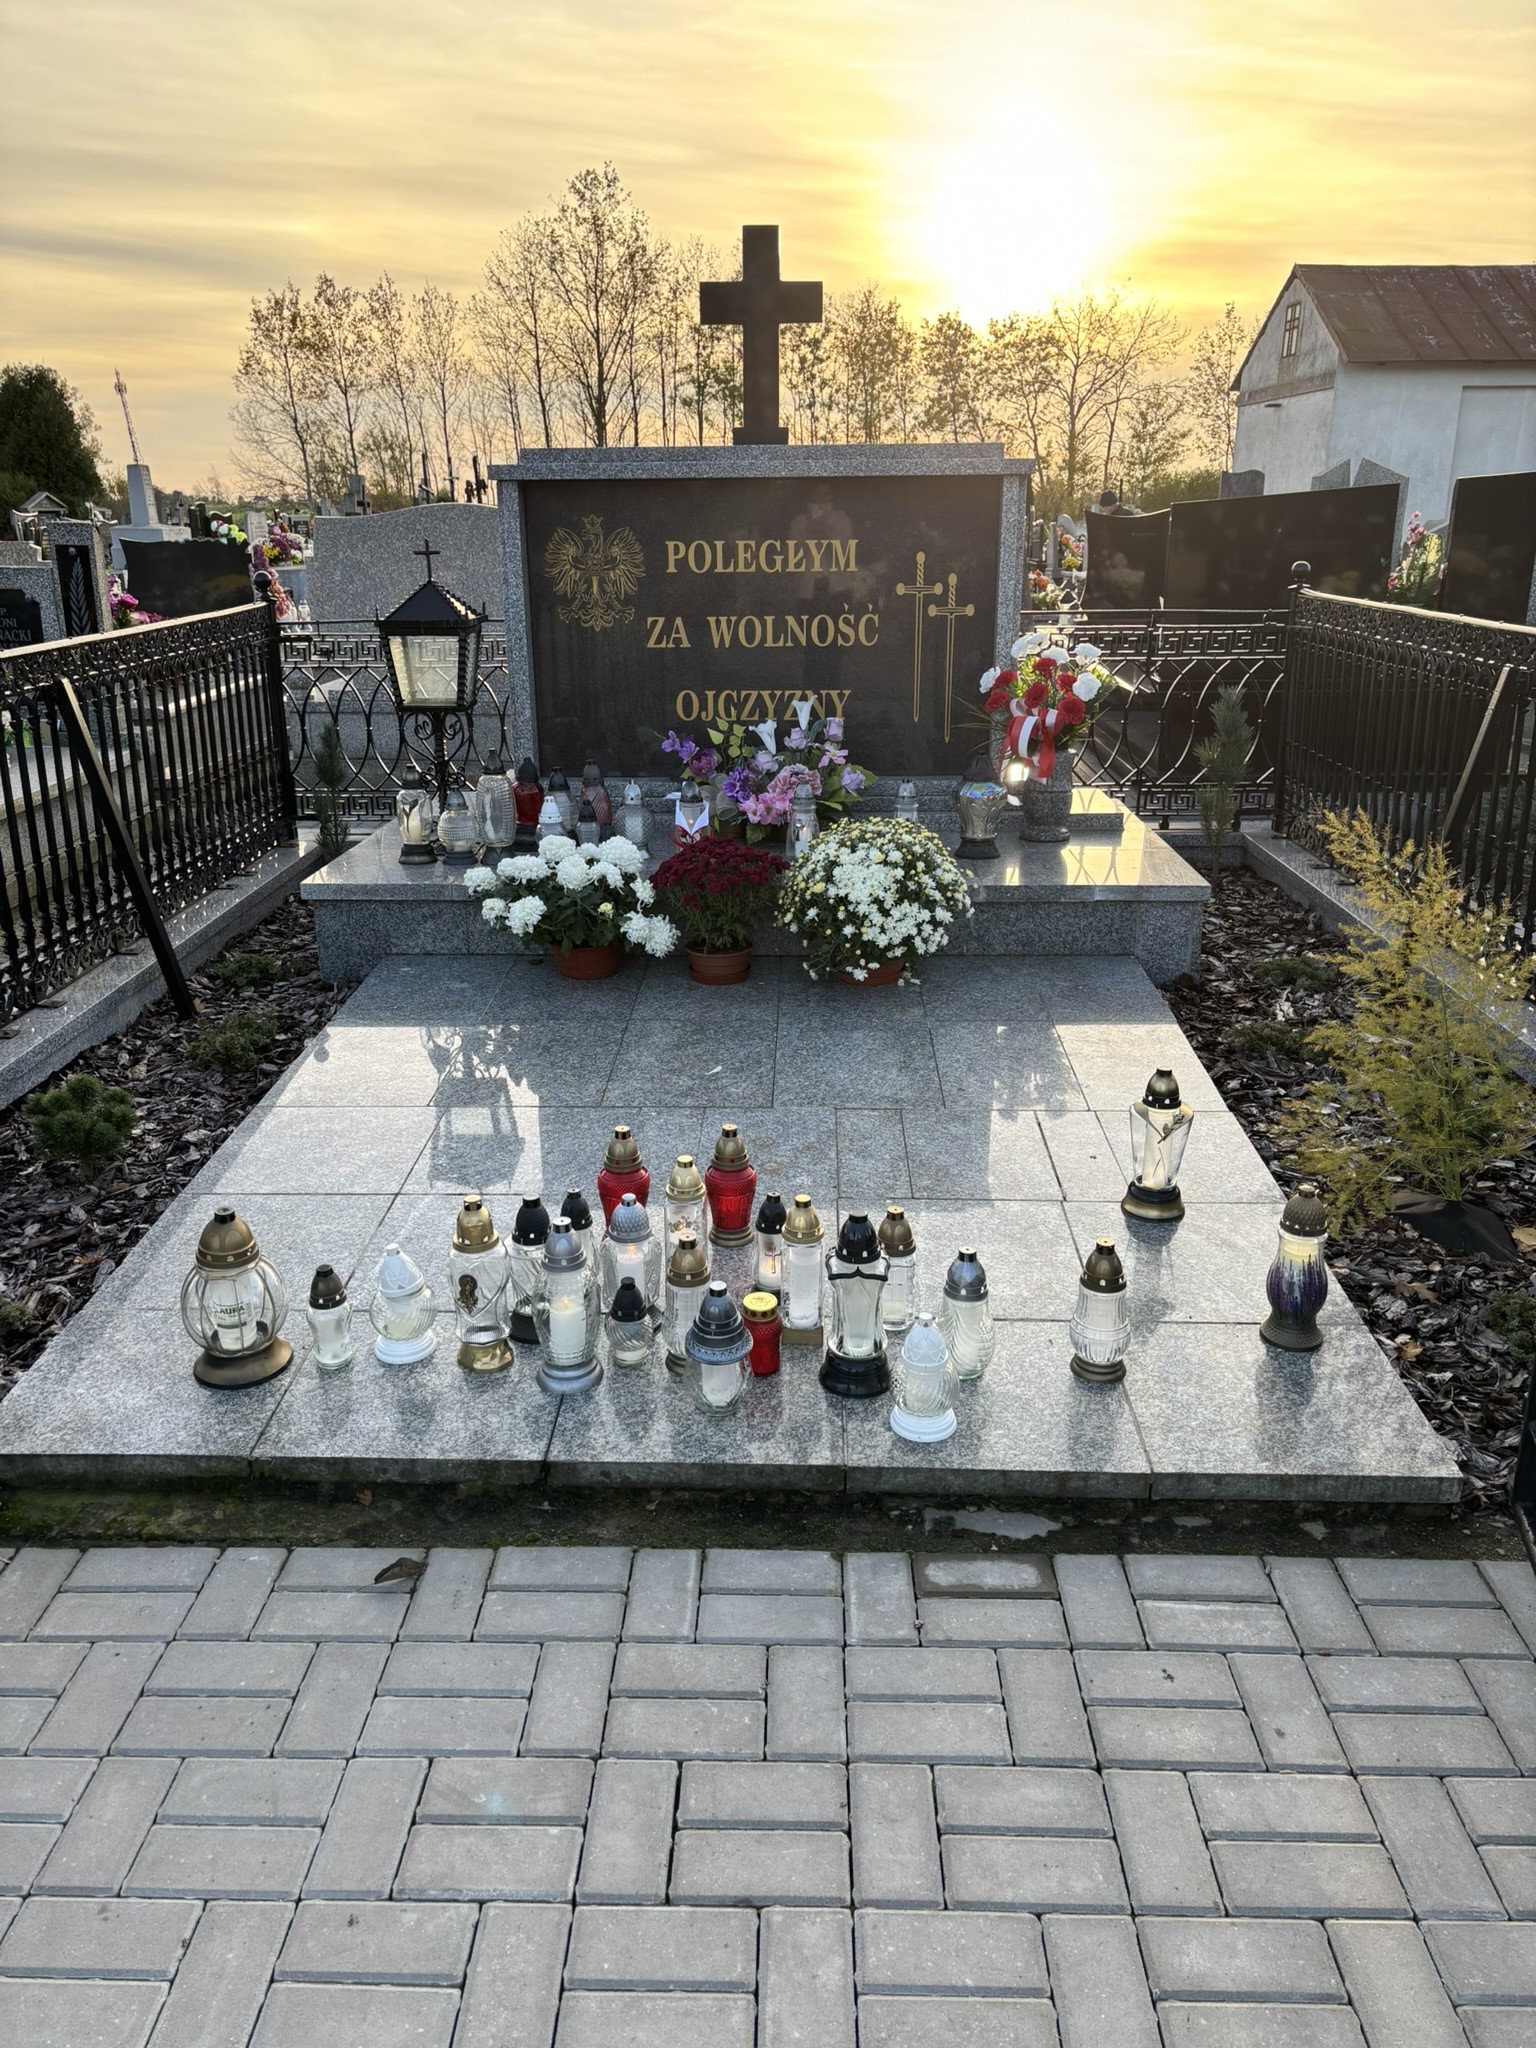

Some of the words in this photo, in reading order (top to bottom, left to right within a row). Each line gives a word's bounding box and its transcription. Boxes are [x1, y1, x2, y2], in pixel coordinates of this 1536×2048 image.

[665, 538, 859, 573] POLEGŁYM
[646, 616, 692, 648] ZA
[675, 689, 851, 722] OJCZYZNY
